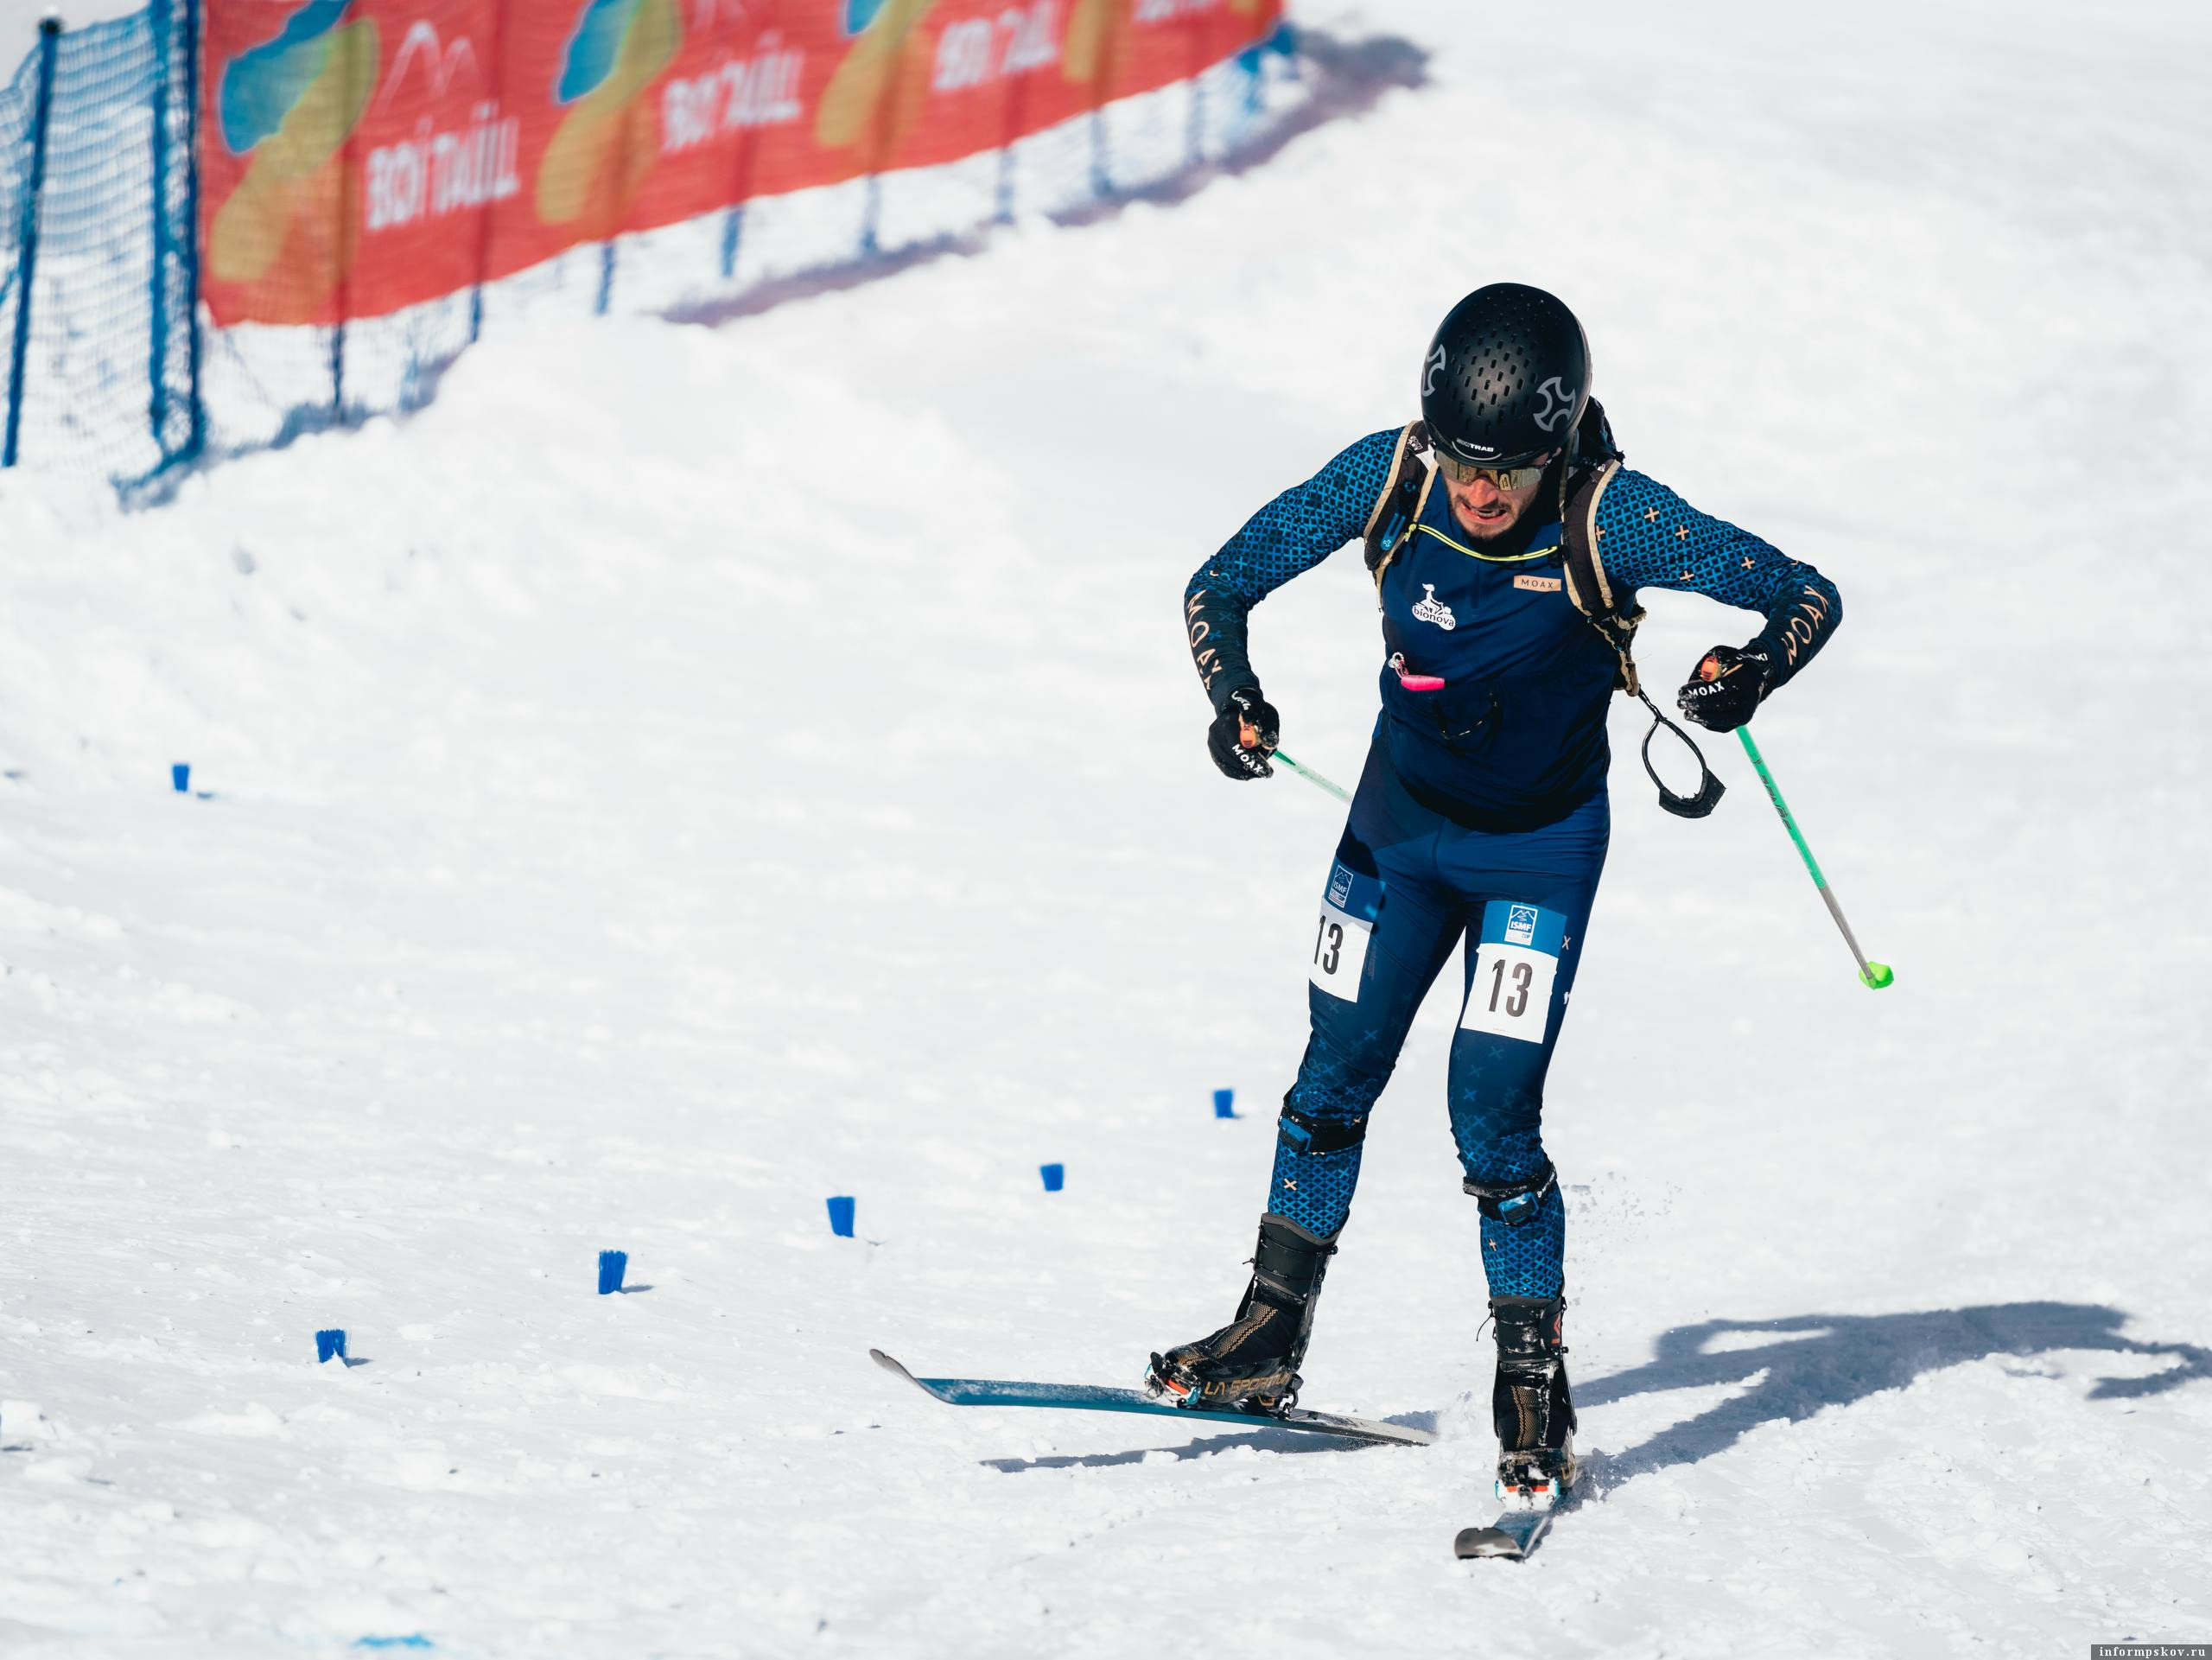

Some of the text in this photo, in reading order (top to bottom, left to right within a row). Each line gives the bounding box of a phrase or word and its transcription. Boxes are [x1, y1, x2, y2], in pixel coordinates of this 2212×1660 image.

[1522, 579, 1553, 588] MOAX
[1414, 607, 1453, 626] bionova
[1781, 585, 1828, 665] MOAX
[1688, 681, 1725, 696] MOAX
[1231, 744, 1263, 773] MOAX
[1333, 881, 1348, 894] ISMF
[1510, 921, 1532, 932] ISMF
[1314, 915, 1344, 975] 13
[1489, 959, 1533, 1017] 13
